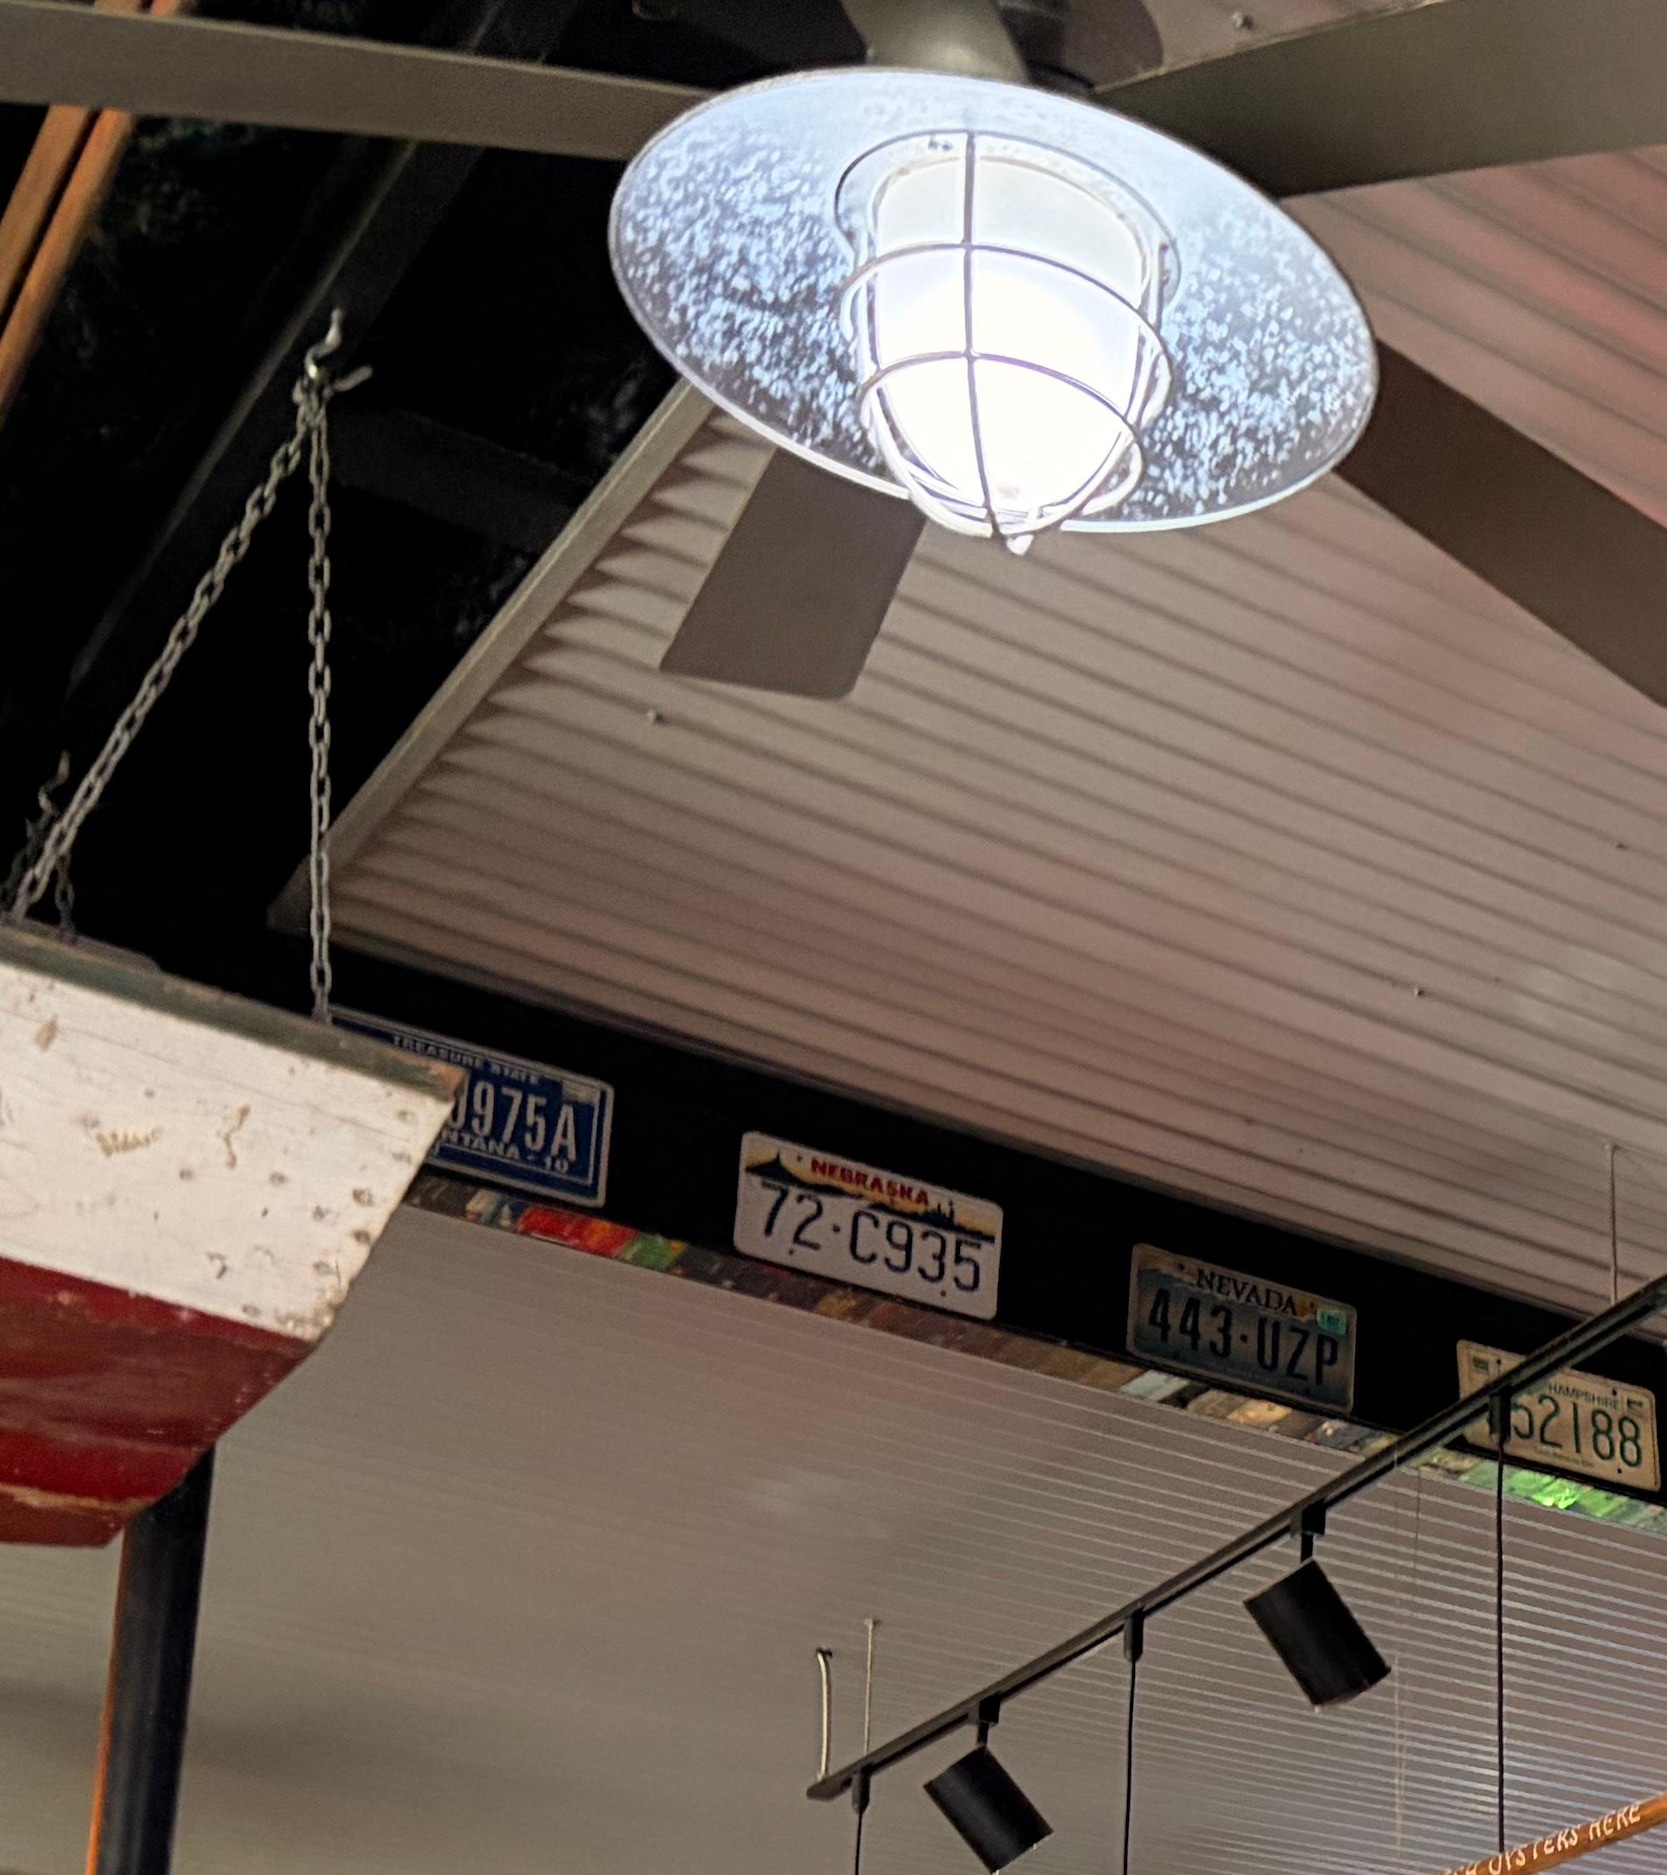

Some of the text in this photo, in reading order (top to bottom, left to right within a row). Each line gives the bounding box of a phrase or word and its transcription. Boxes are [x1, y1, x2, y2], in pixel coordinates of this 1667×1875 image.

[811, 1158, 929, 1206] NEBRASKA
[1196, 1269, 1298, 1317] NEVADA
[1589, 1802, 1643, 1840] HERE
